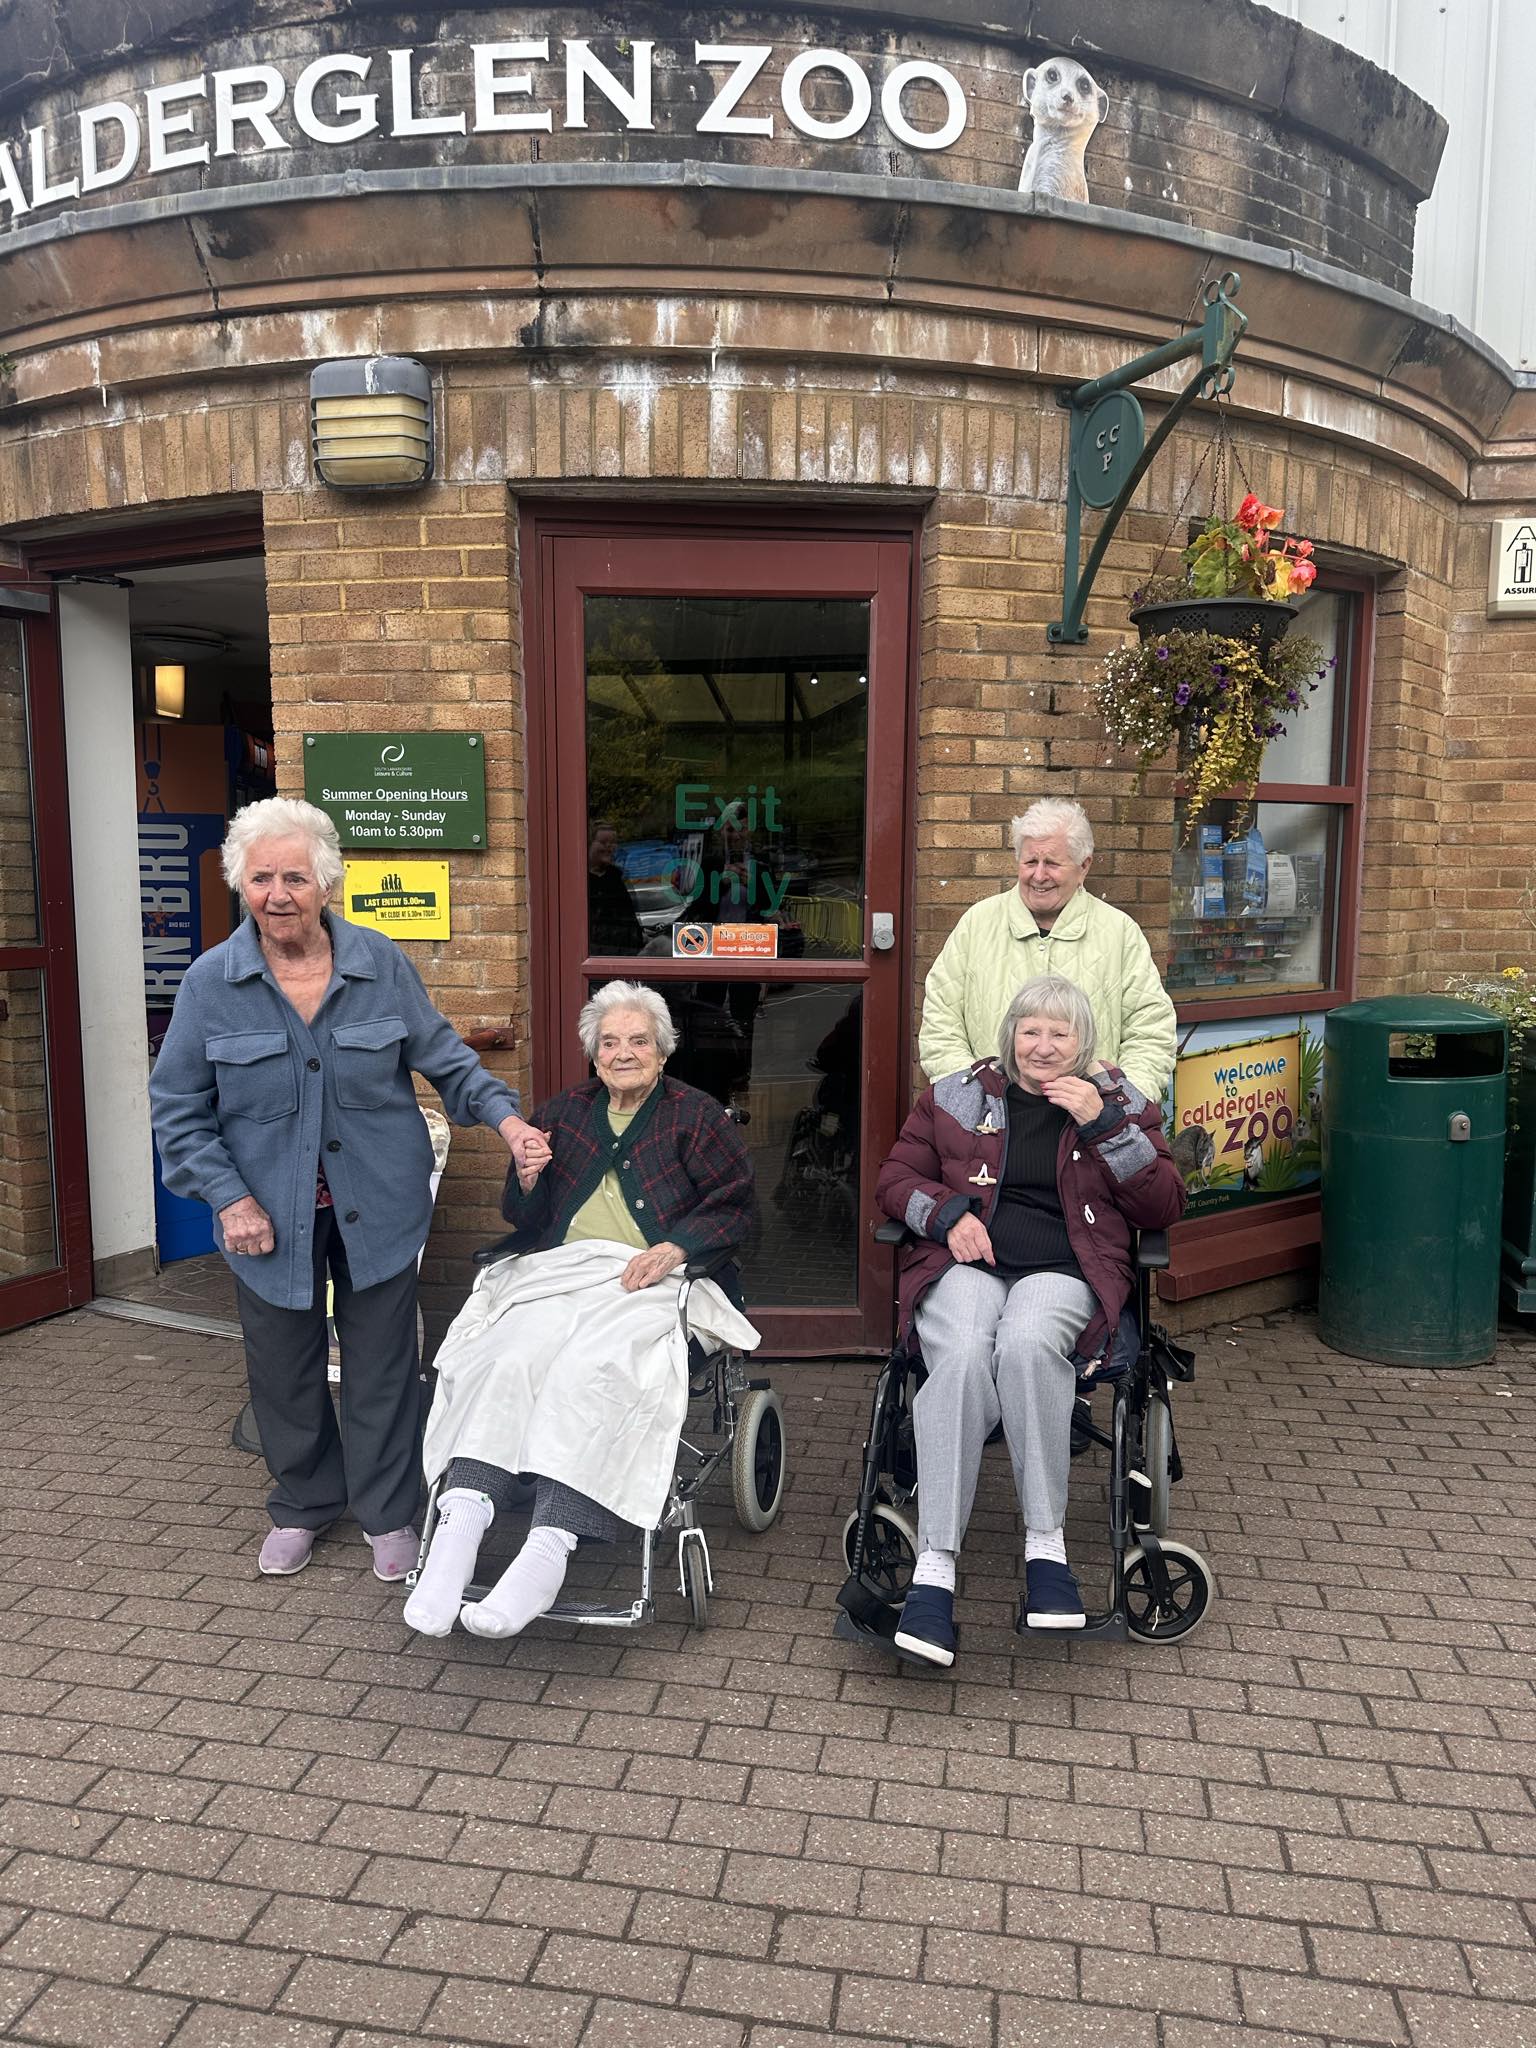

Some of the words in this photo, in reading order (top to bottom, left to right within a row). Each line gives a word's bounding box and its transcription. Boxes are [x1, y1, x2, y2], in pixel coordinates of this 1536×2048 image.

[694, 40, 967, 150] ZOO
[1102, 451, 1113, 472] P
[1504, 587, 1536, 595] ASSUR
[322, 788, 373, 800] Summer
[375, 788, 428, 803] Opening
[429, 788, 469, 800] Hours
[675, 783, 784, 832] Exit
[345, 810, 391, 823] Monday
[401, 809, 446, 823] Sunday
[349, 826, 381, 837] 10am
[384, 826, 397, 837] to
[399, 826, 444, 839] 5.30pm
[661, 857, 791, 917] Only
[364, 898, 380, 907] LAST
[381, 897, 402, 907] ENTRY
[380, 911, 388, 919] WE
[388, 910, 401, 918] CLOSE
[719, 930, 735, 941] No
[740, 929, 769, 944] dogs
[738, 945, 755, 953] guide
[755, 945, 771, 953] dogs
[1225, 1085, 1238, 1098] to
[1220, 1105, 1293, 1153] ZOO
